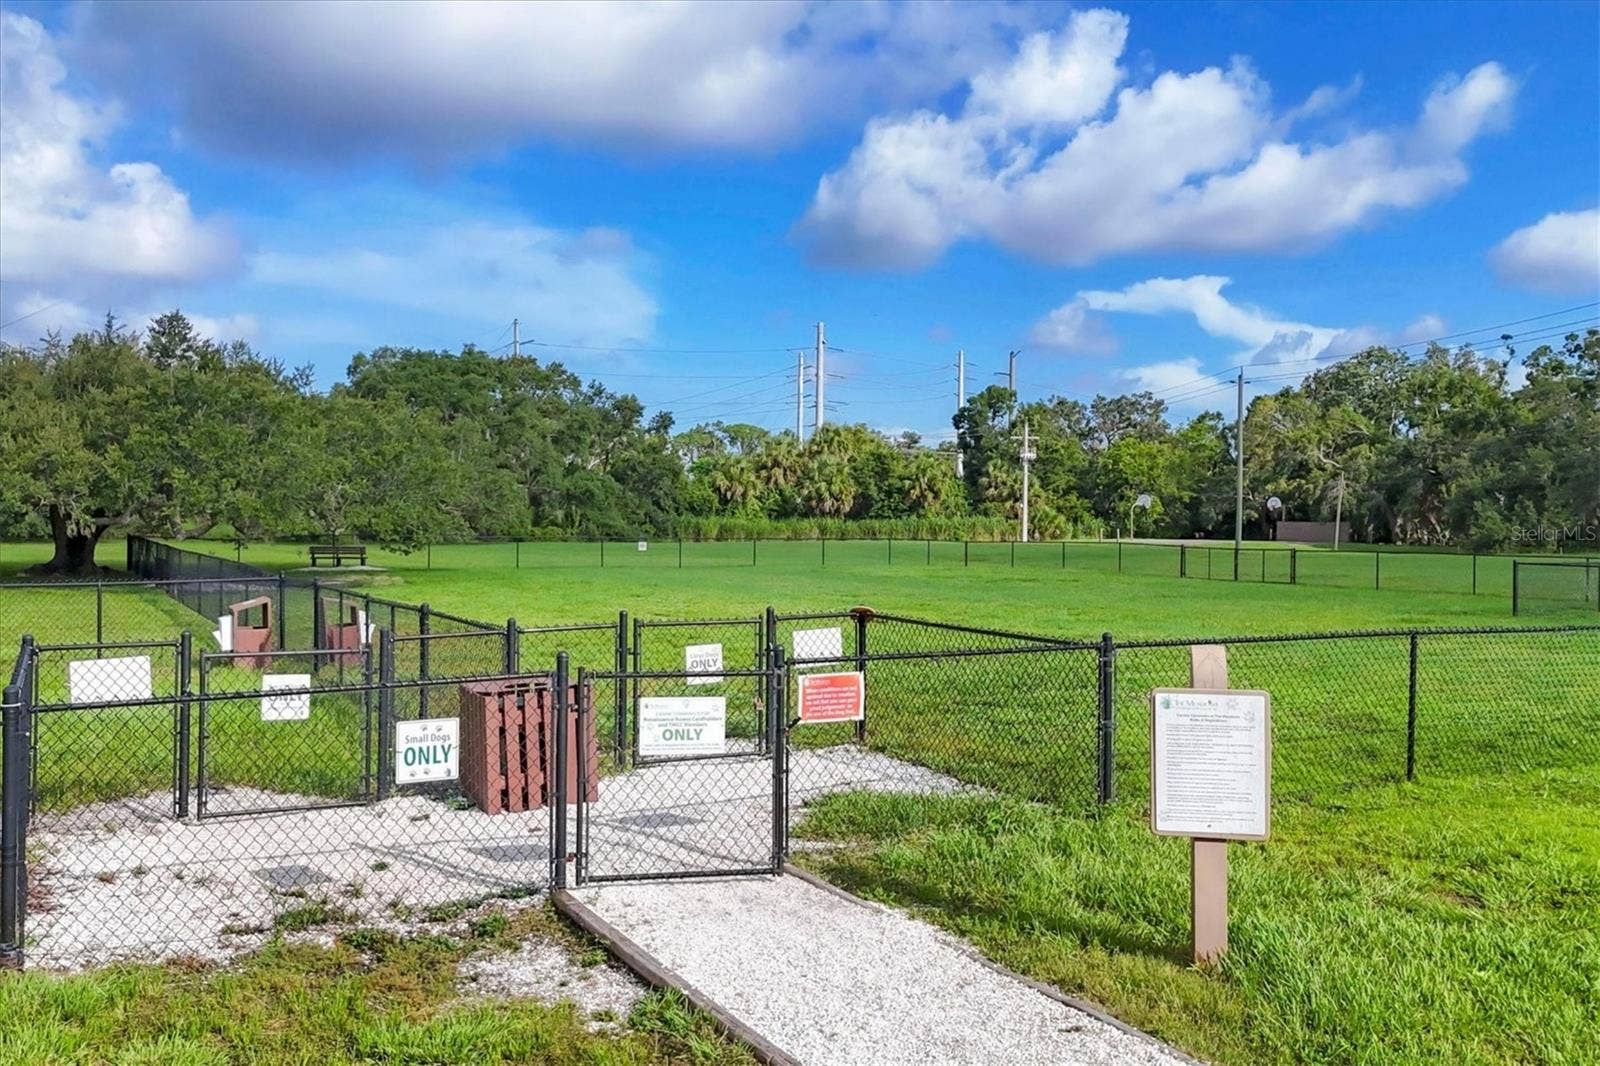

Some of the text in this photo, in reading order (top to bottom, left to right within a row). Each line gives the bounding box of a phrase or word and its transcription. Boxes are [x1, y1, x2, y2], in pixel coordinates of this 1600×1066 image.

[691, 658, 718, 669] ONLY
[405, 732, 451, 744] Small Dogs
[662, 728, 703, 741] ONLY
[404, 743, 452, 766] ONLY
